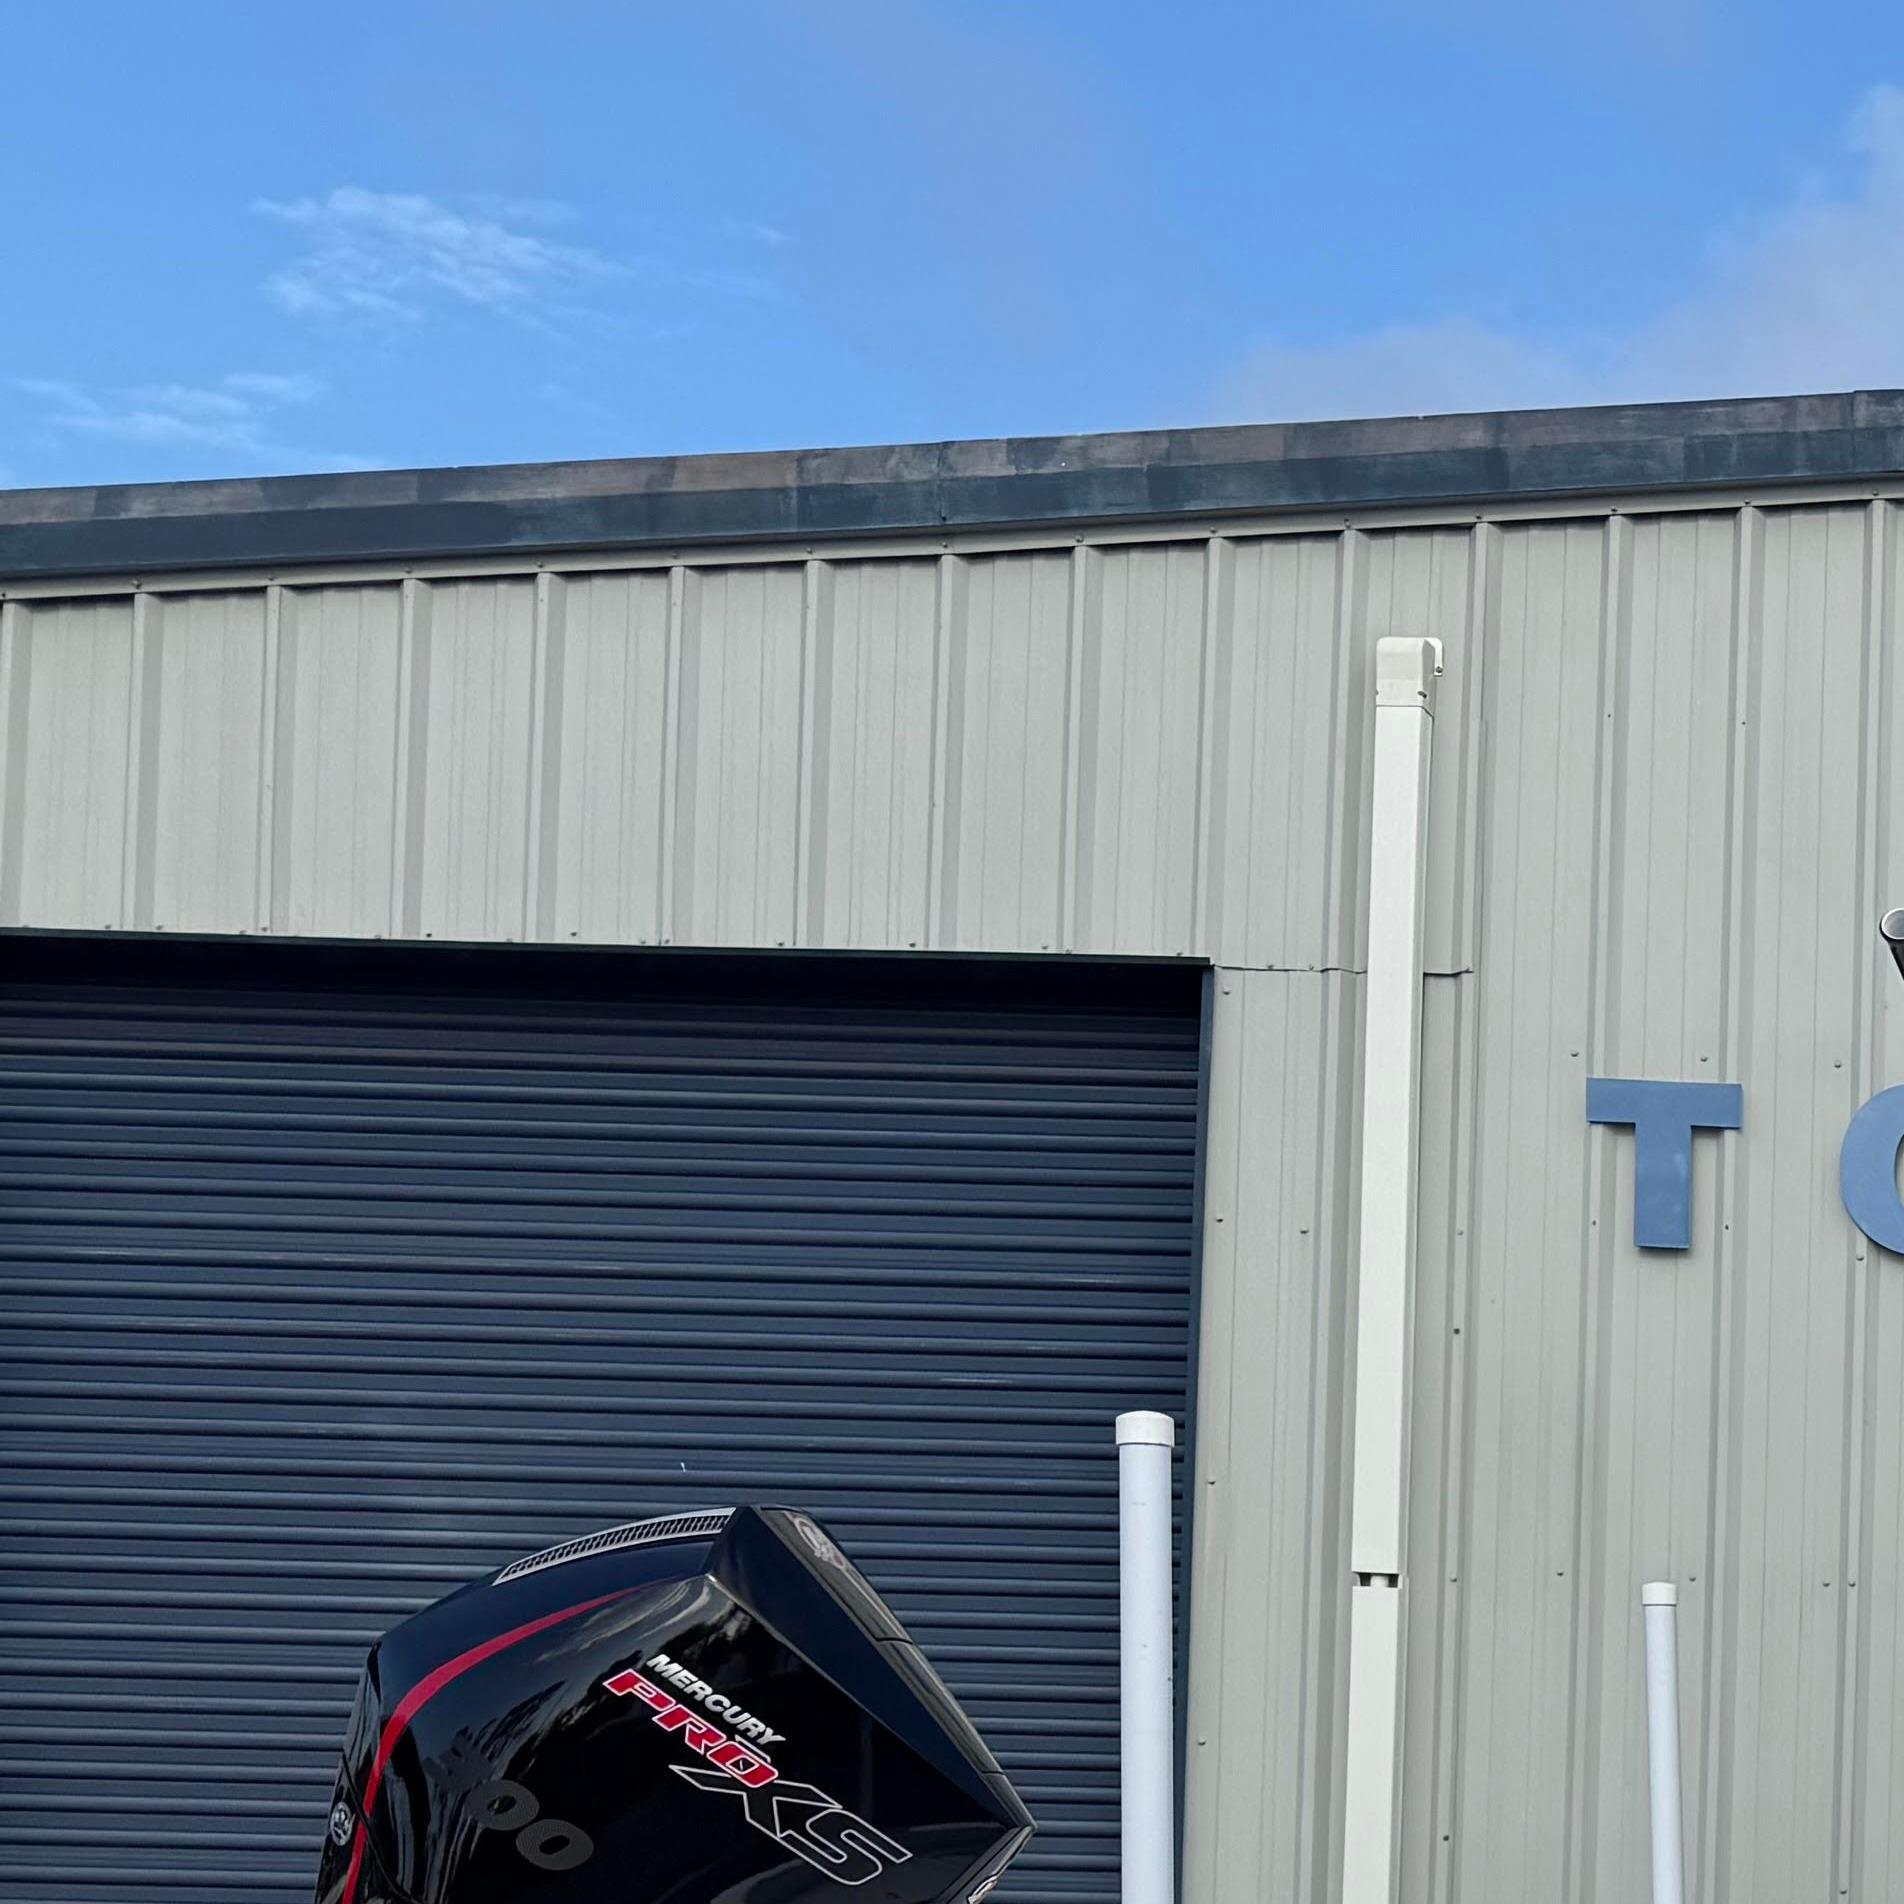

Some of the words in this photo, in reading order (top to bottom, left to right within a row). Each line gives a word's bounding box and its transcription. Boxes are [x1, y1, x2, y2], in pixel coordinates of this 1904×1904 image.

[602, 1668, 780, 1788] PRO
[646, 1653, 786, 1746] MERCURY
[668, 1734, 913, 1885] XS
